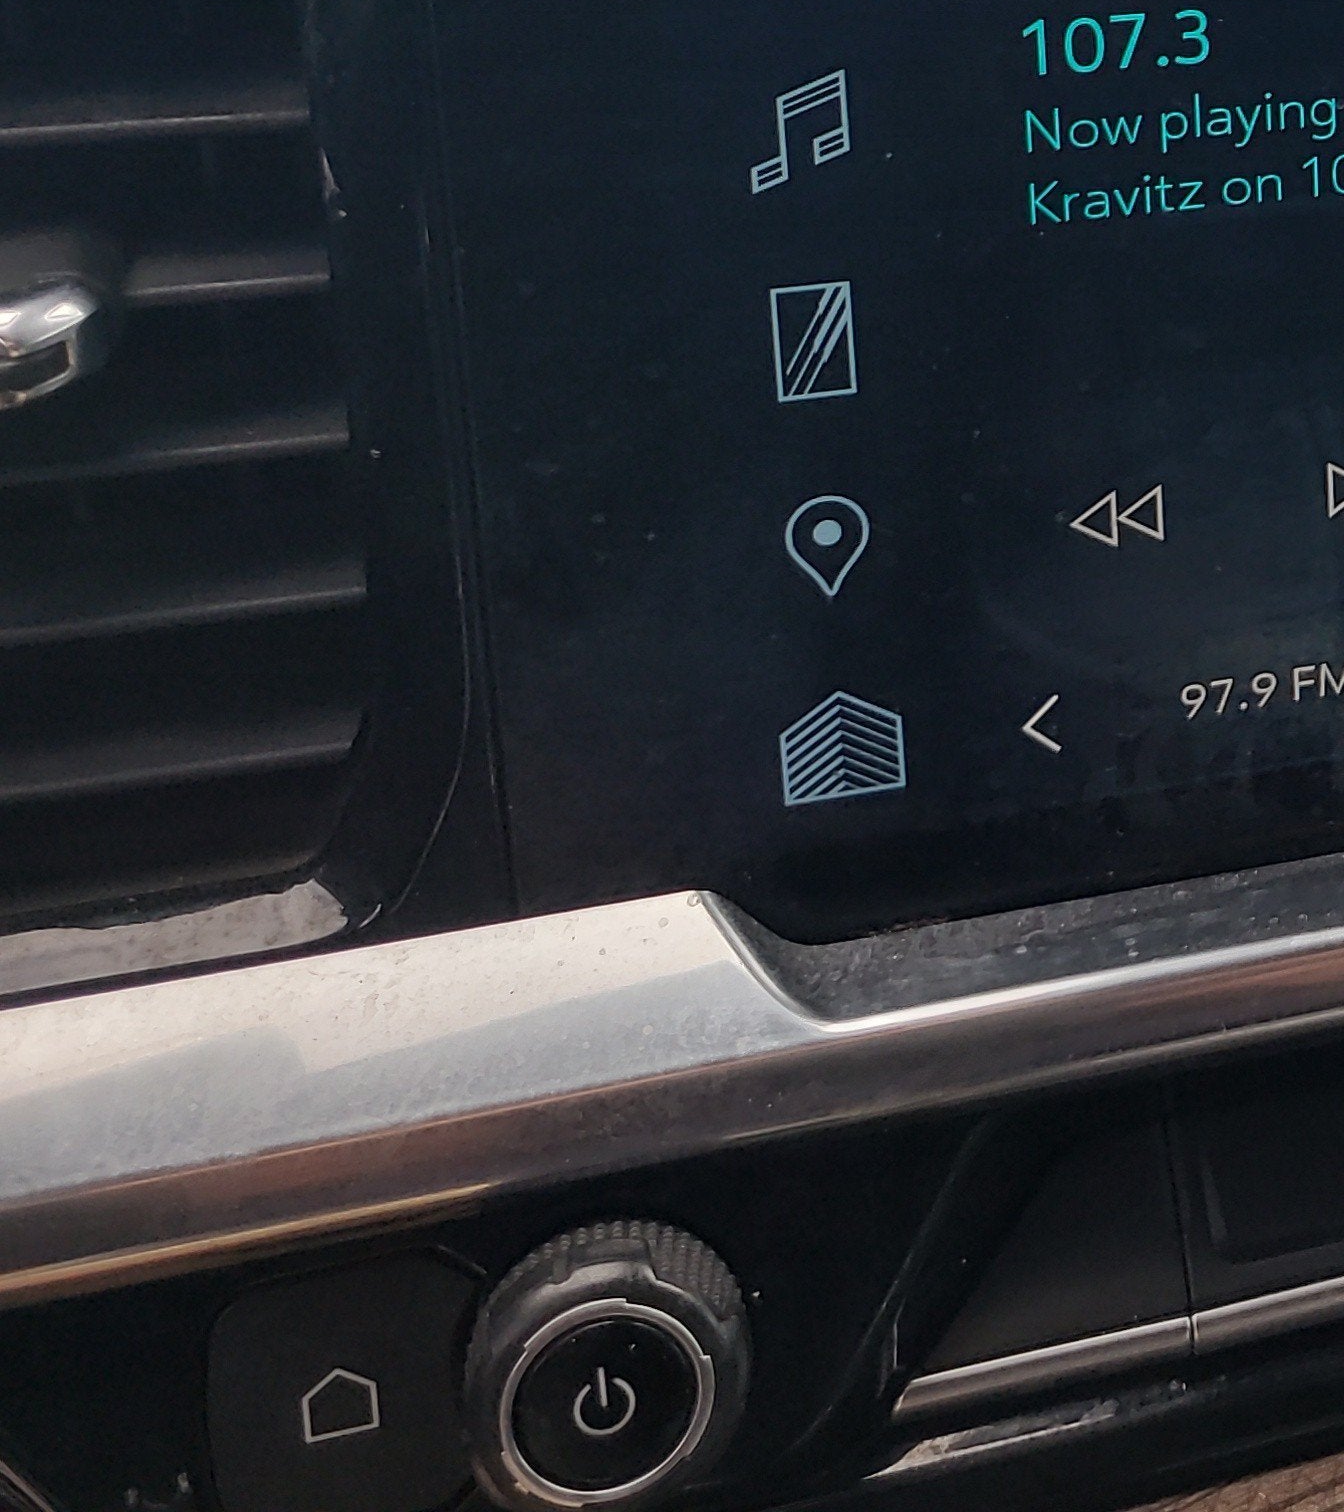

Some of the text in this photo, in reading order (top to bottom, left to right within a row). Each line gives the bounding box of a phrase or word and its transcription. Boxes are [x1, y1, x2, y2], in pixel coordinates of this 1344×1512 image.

[1021, 9, 1211, 76] 107.3
[1024, 107, 1142, 153] Now
[1160, 93, 1338, 153] playing
[1028, 174, 1205, 226] Kravitz
[1221, 173, 1283, 206] on
[1179, 671, 1278, 721] 97.9
